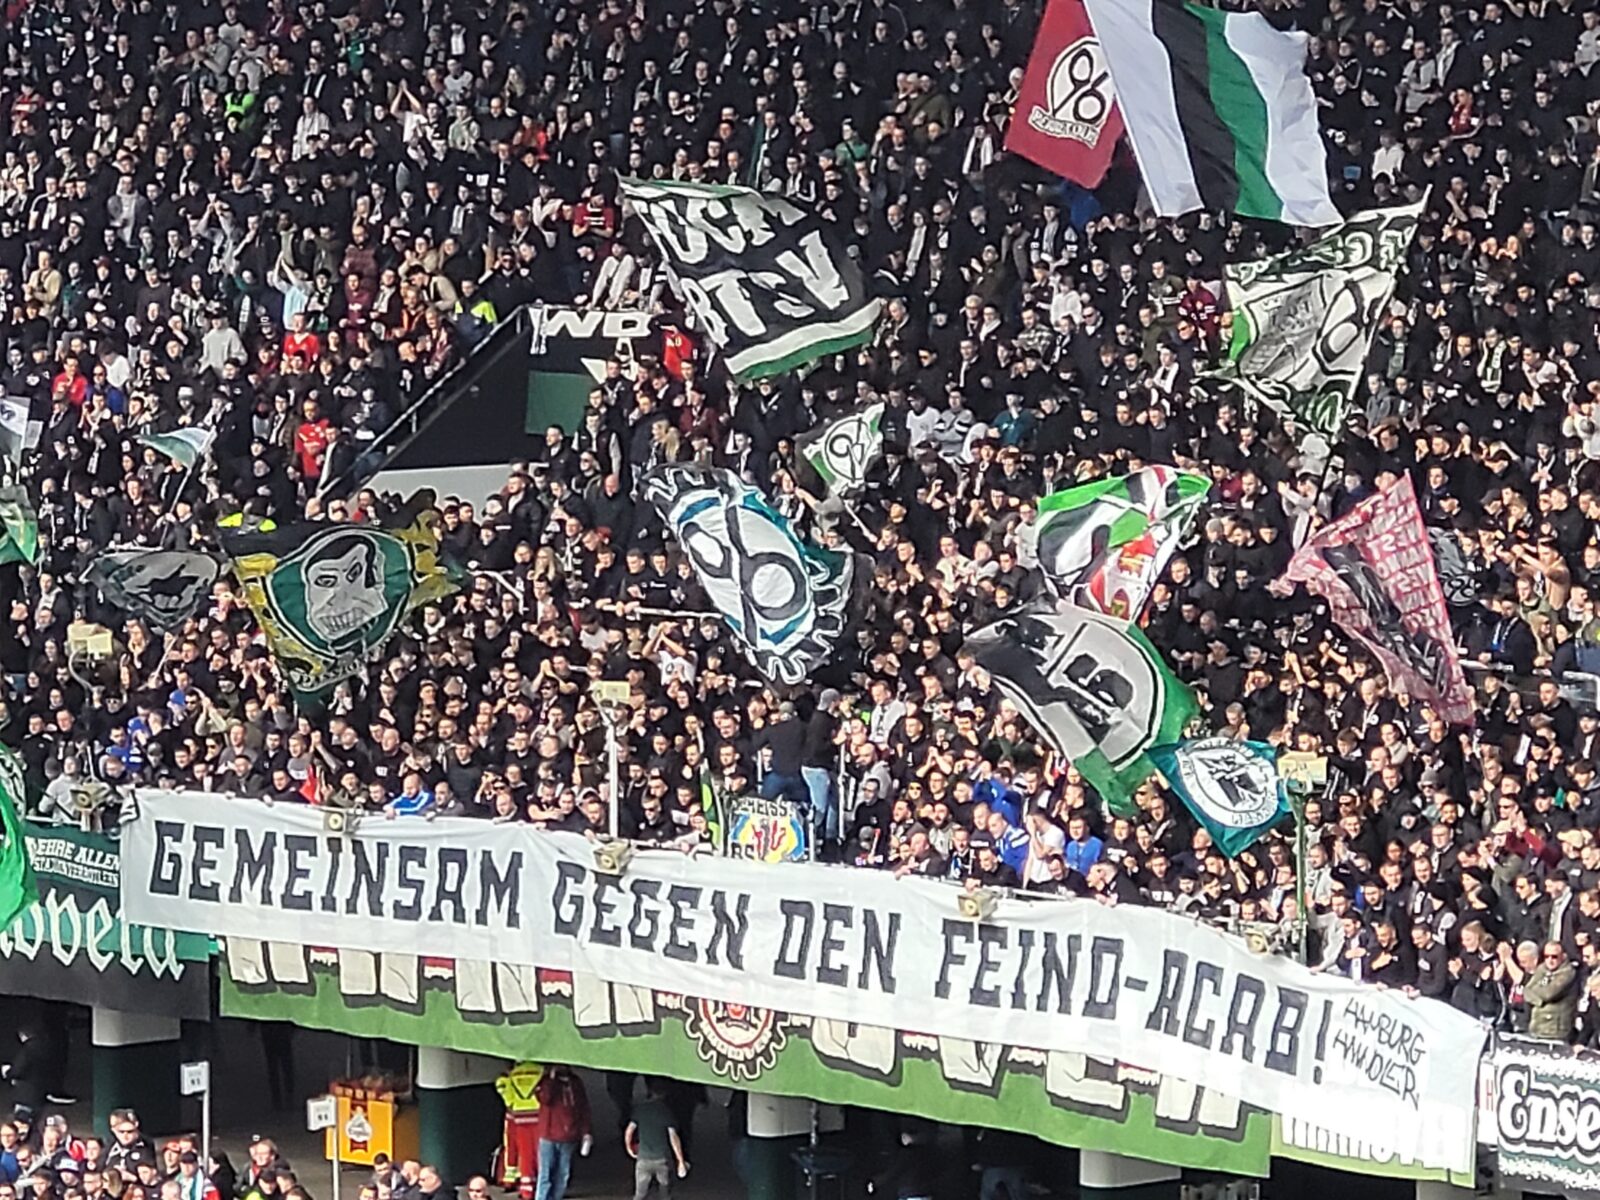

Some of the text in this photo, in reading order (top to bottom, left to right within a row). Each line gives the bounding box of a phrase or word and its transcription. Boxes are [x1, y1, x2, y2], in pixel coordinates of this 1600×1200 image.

[680, 230, 850, 350] BTSV
[149, 820, 523, 929] GEMEINSAM
[553, 861, 750, 970] GEGEN
[773, 899, 901, 993] DEN
